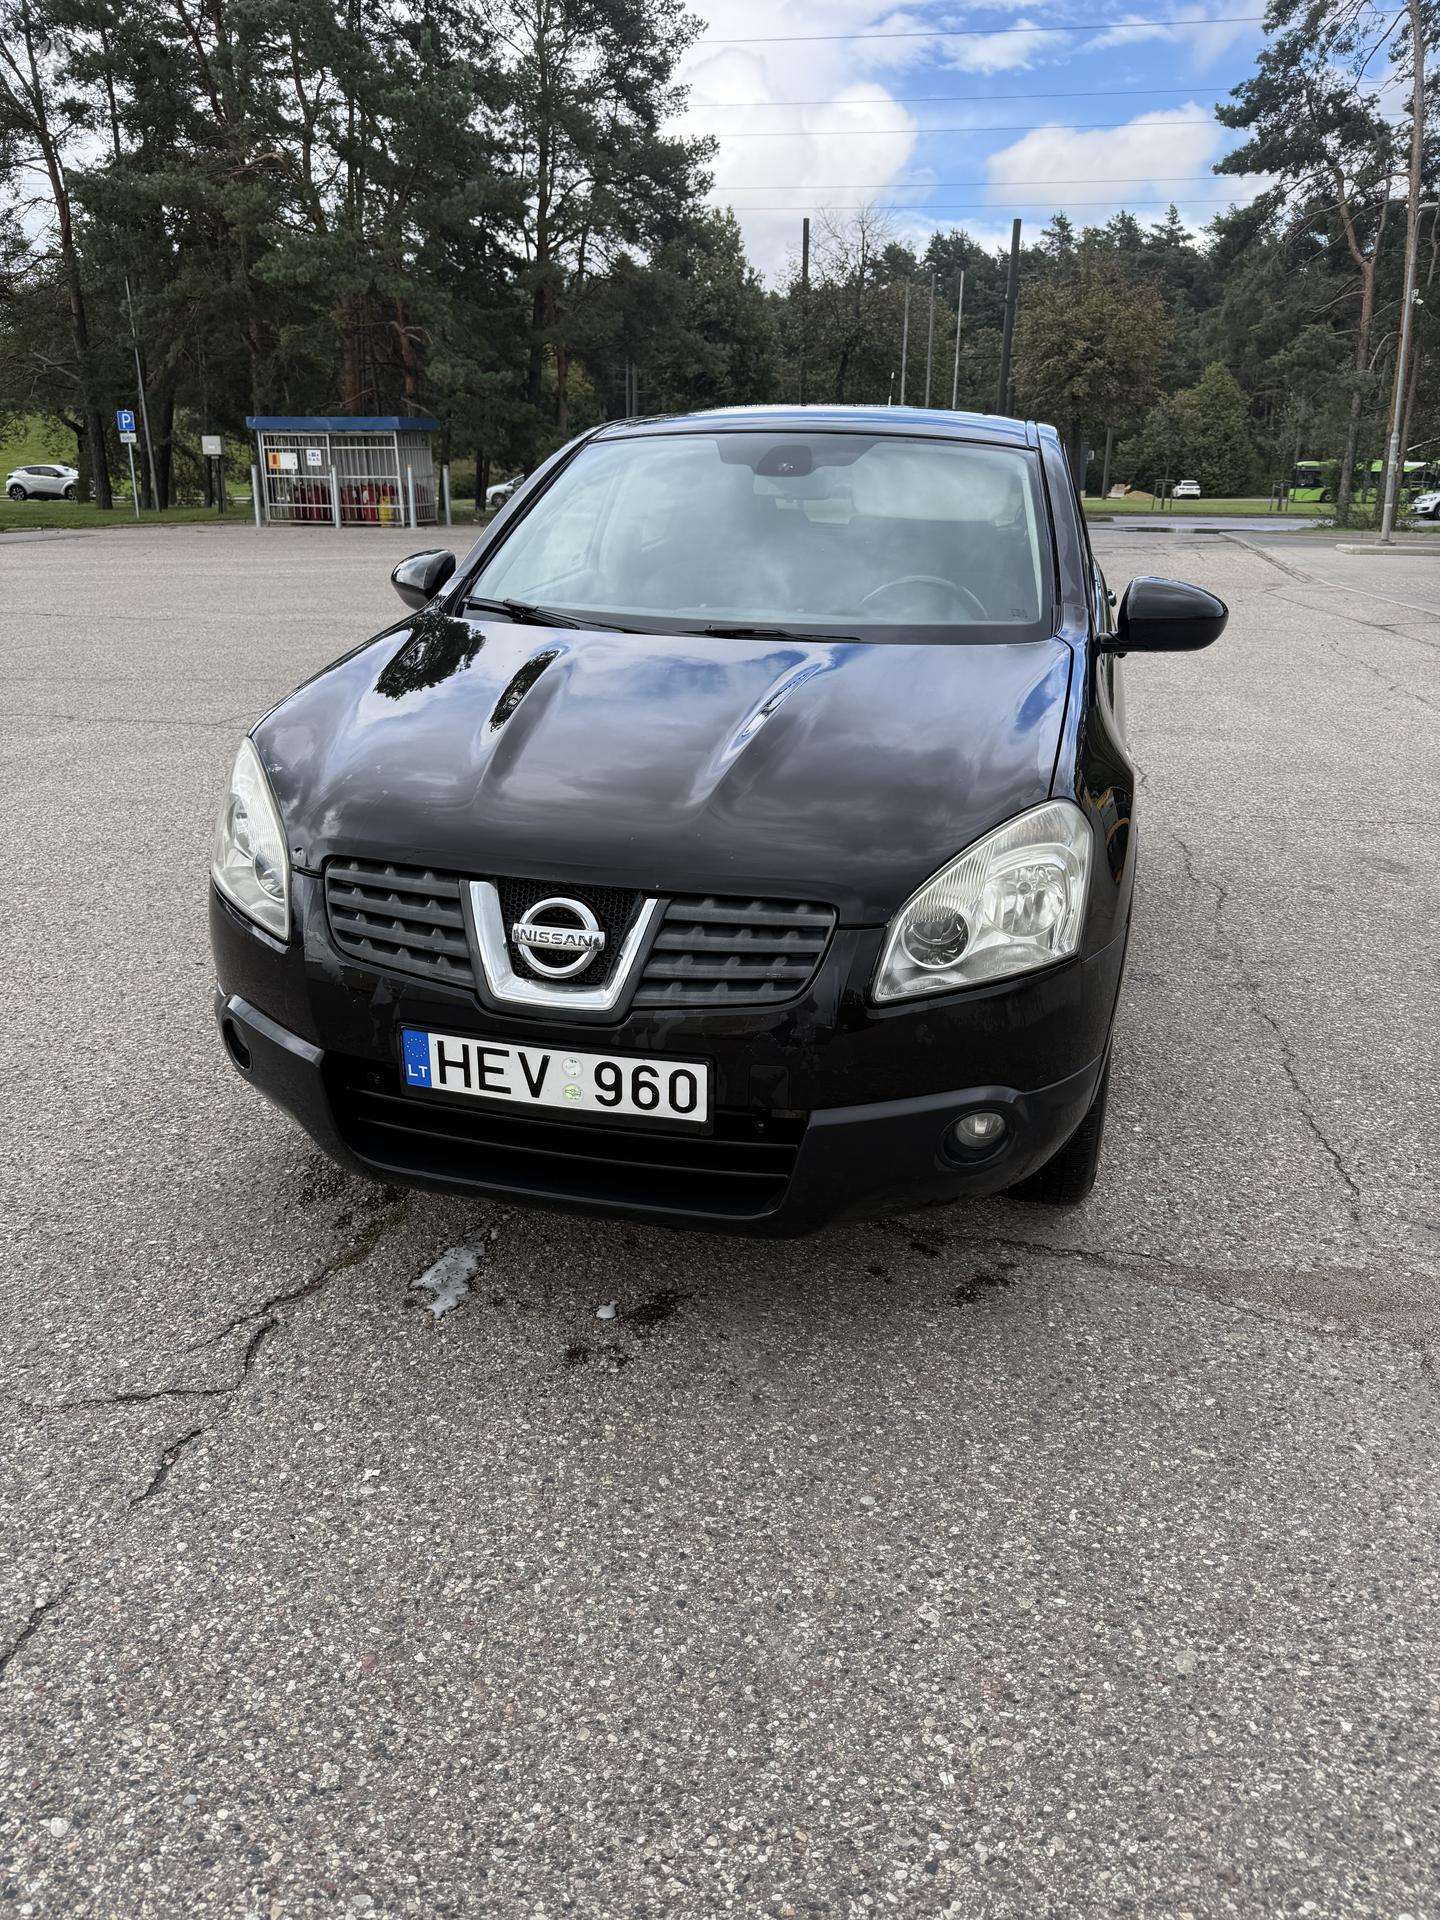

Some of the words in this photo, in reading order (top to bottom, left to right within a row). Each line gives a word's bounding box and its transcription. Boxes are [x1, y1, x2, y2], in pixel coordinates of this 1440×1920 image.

[121, 414, 131, 428] P
[518, 929, 593, 947] NISSAN
[408, 1064, 427, 1078] LT
[436, 1040, 551, 1098] HEV
[594, 1061, 698, 1114] 960
